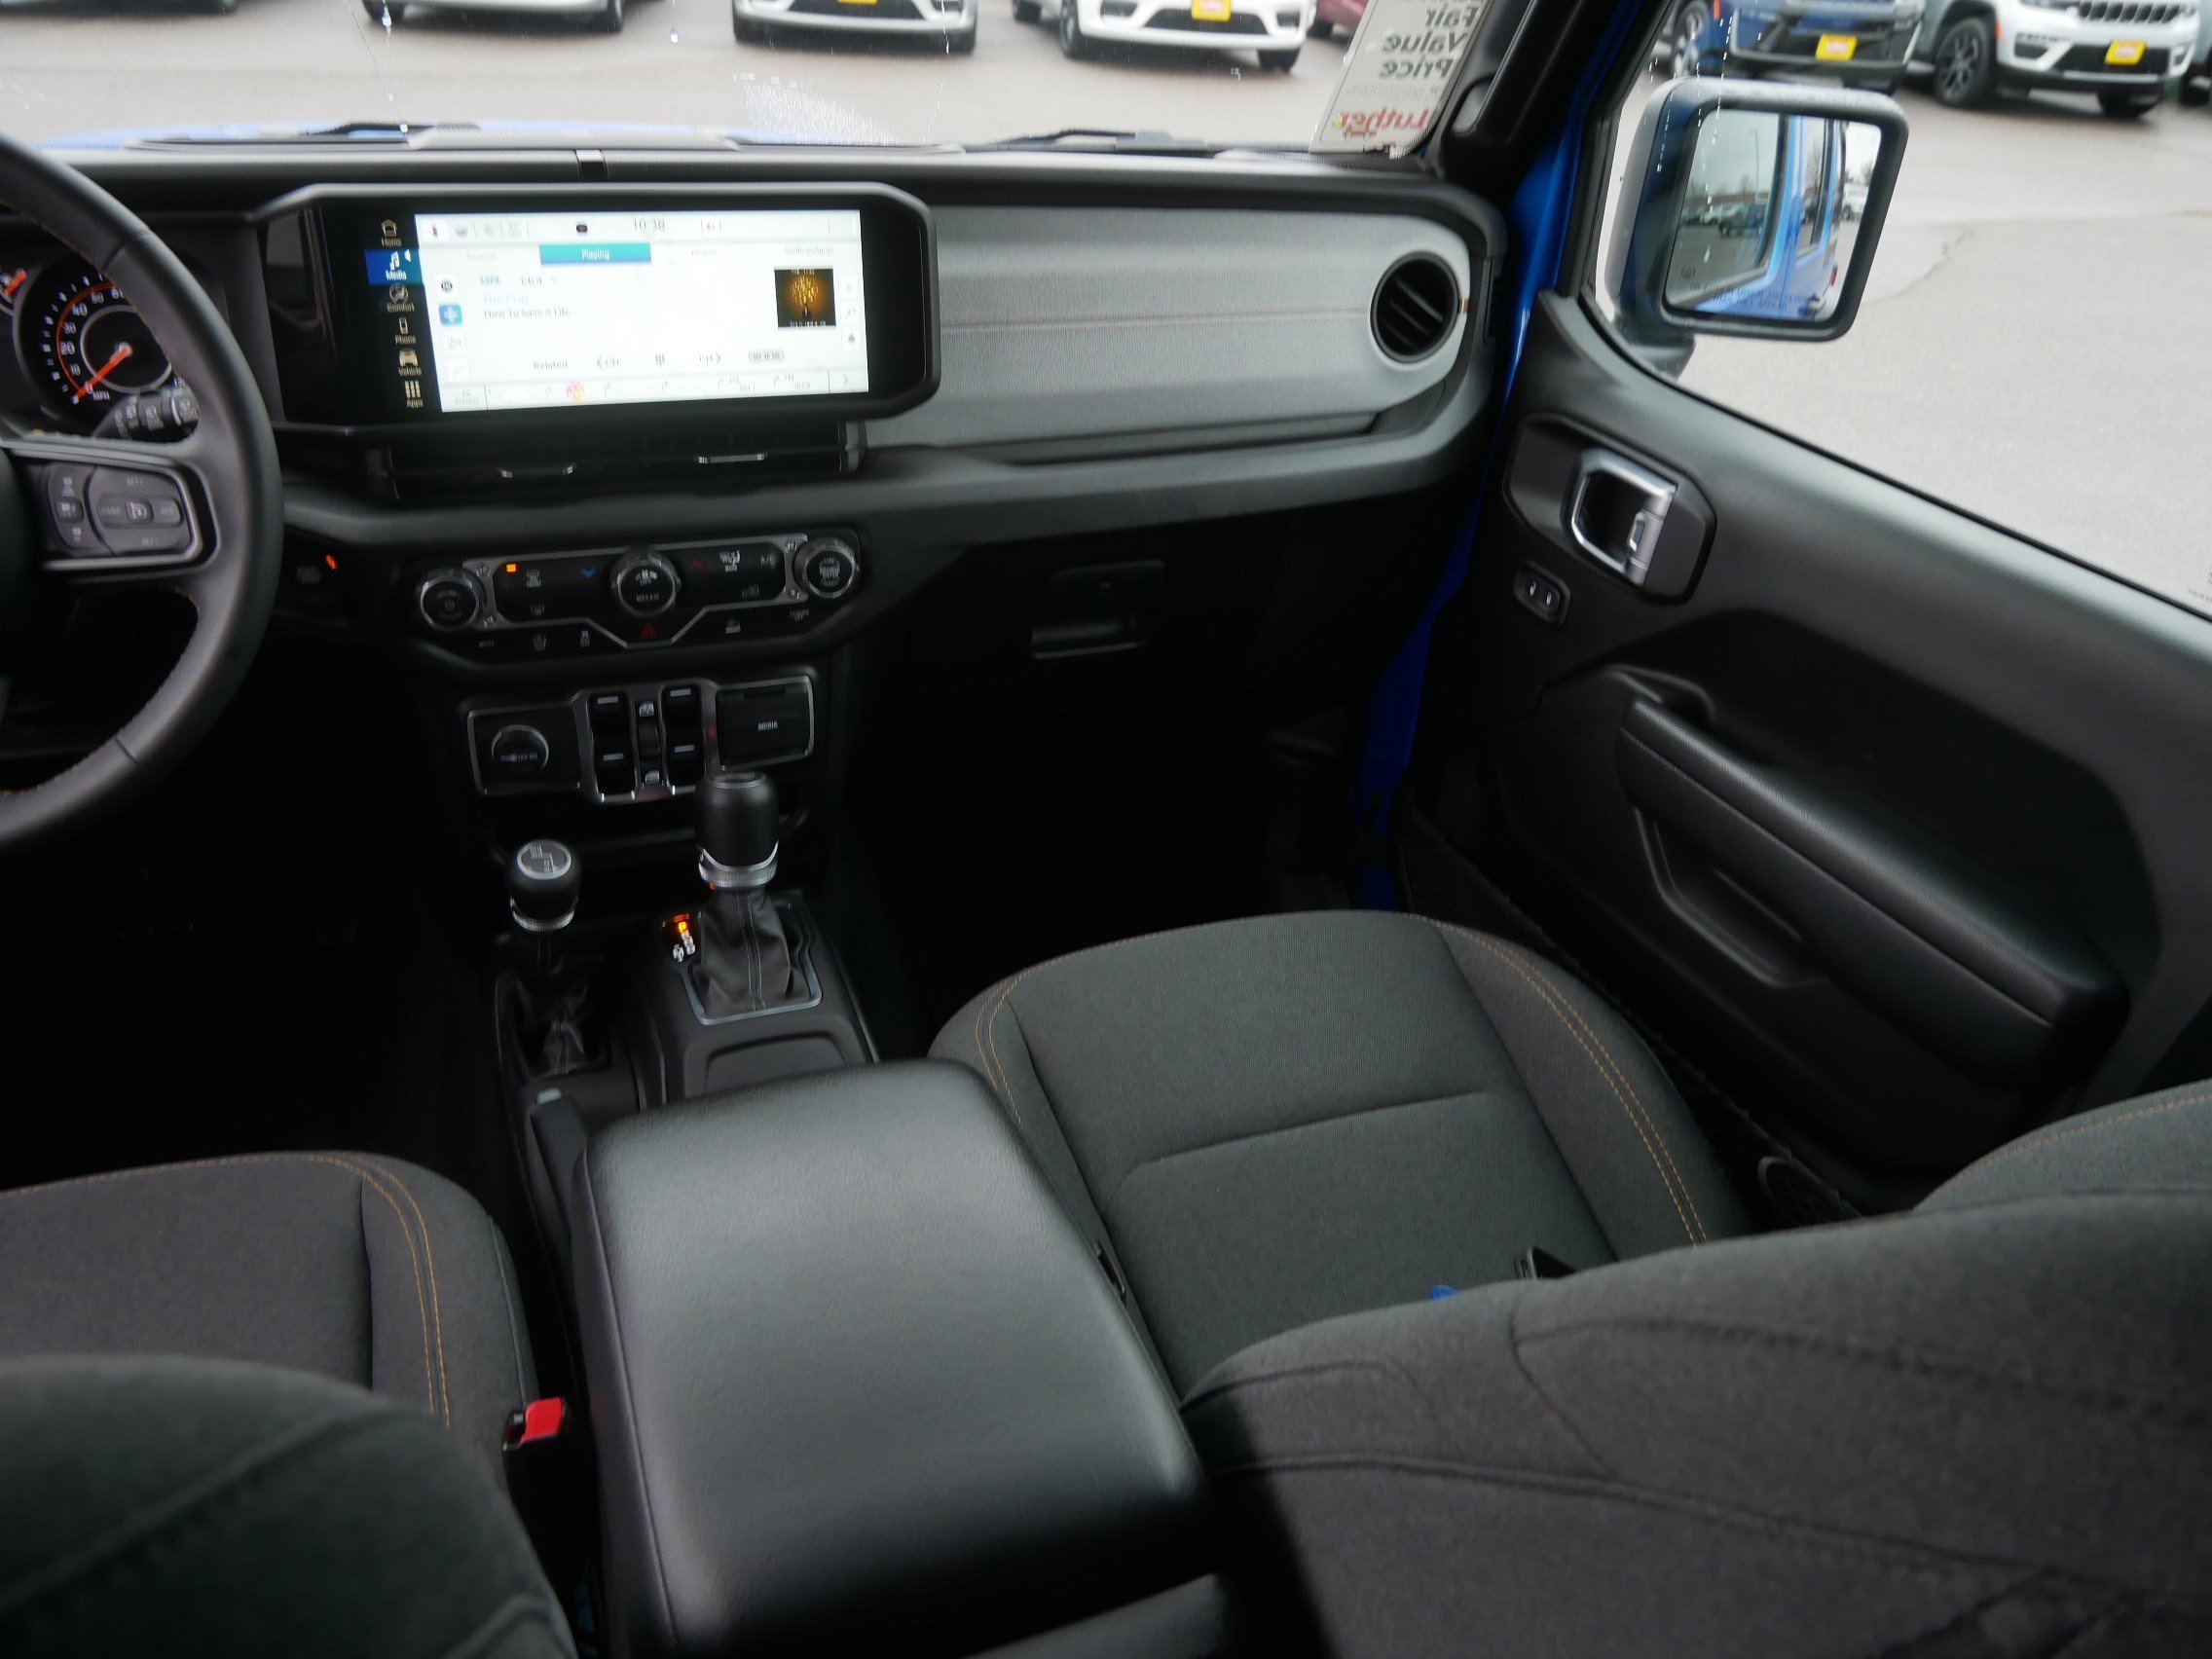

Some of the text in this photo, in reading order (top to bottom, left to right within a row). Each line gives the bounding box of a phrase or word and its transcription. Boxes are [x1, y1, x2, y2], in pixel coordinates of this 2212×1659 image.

[632, 217, 666, 234] 10:38
[581, 248, 610, 261] Playing
[386, 269, 407, 280] Media
[72, 302, 89, 316] 40
[483, 309, 504, 319] How
[60, 341, 76, 355] 20
[70, 363, 81, 376] 10
[756, 719, 776, 731] MEDIA
